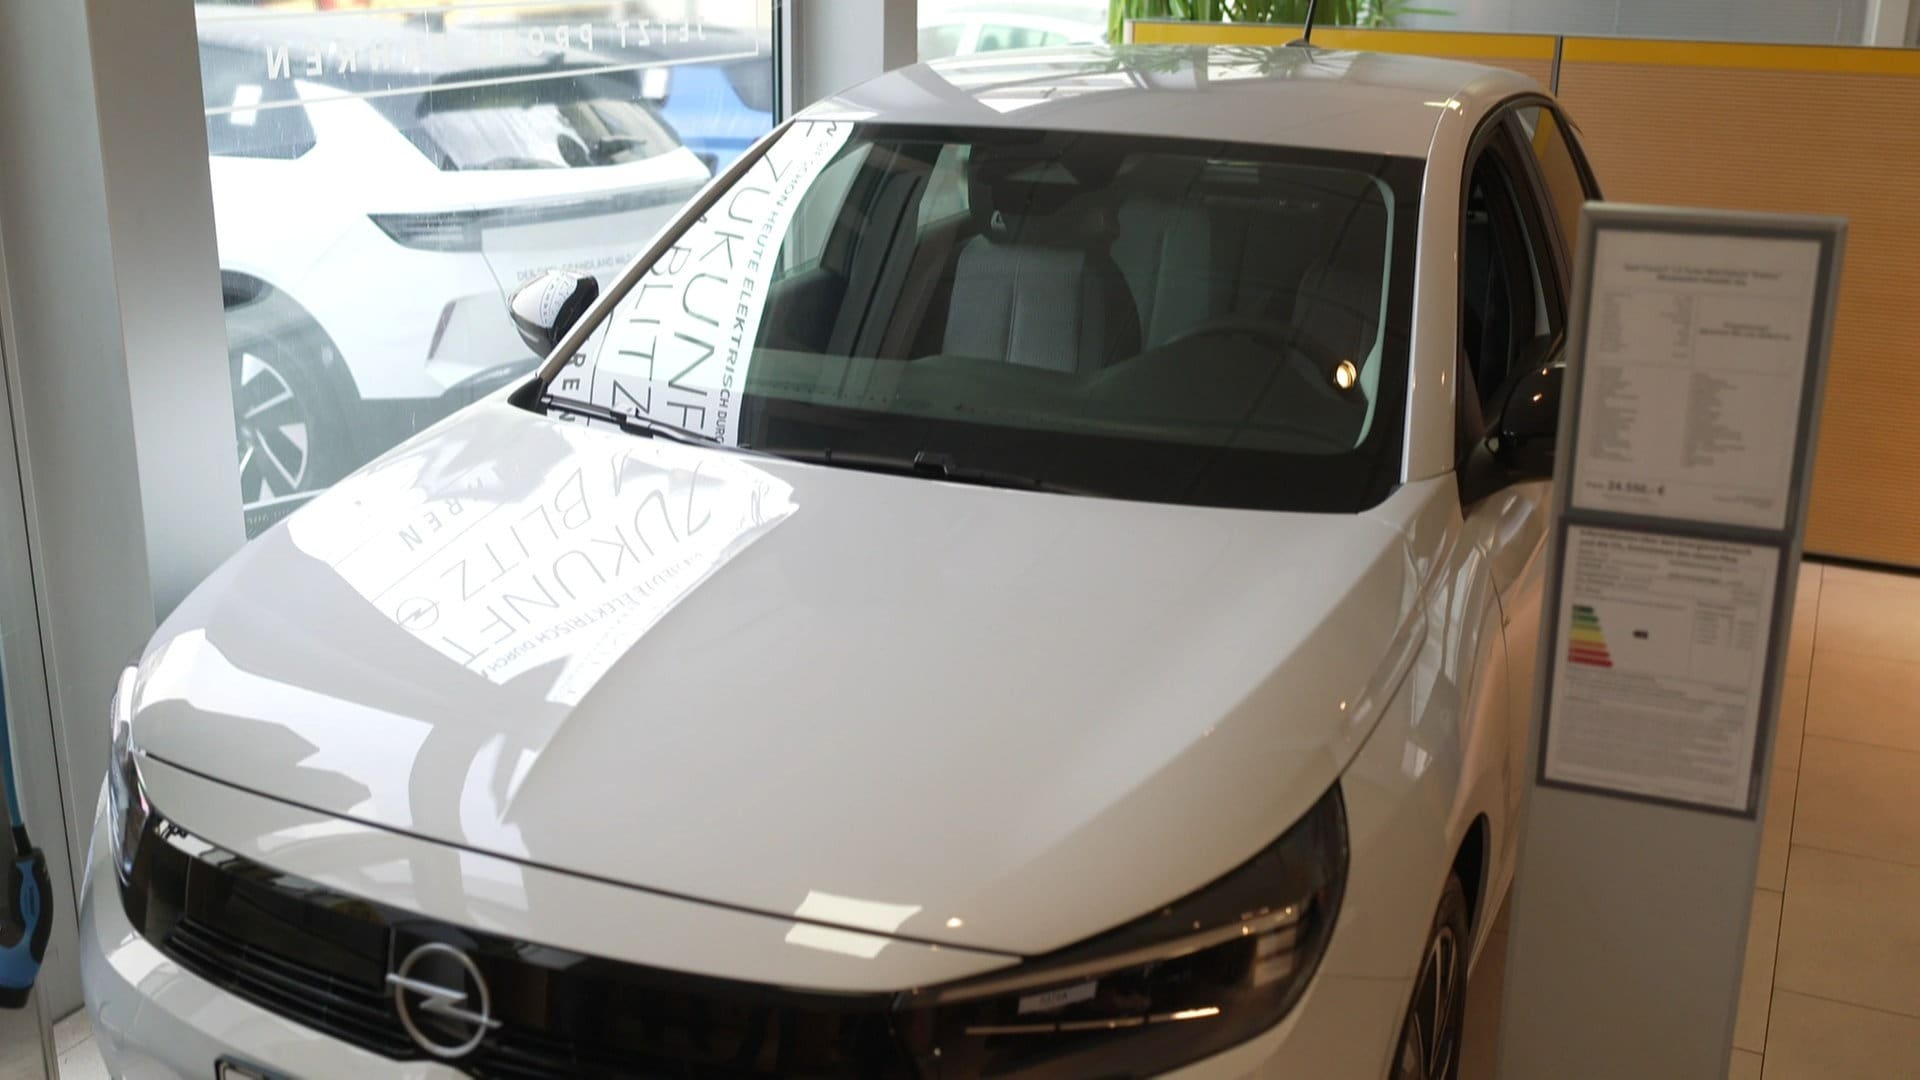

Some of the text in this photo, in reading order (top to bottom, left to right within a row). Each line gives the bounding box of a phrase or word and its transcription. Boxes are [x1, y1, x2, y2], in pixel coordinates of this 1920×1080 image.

[746, 210, 779, 270] HEUTE
[612, 245, 692, 414] BLITZ
[718, 277, 755, 403] ELEKTRISCH
[440, 467, 592, 602] BLITZ
